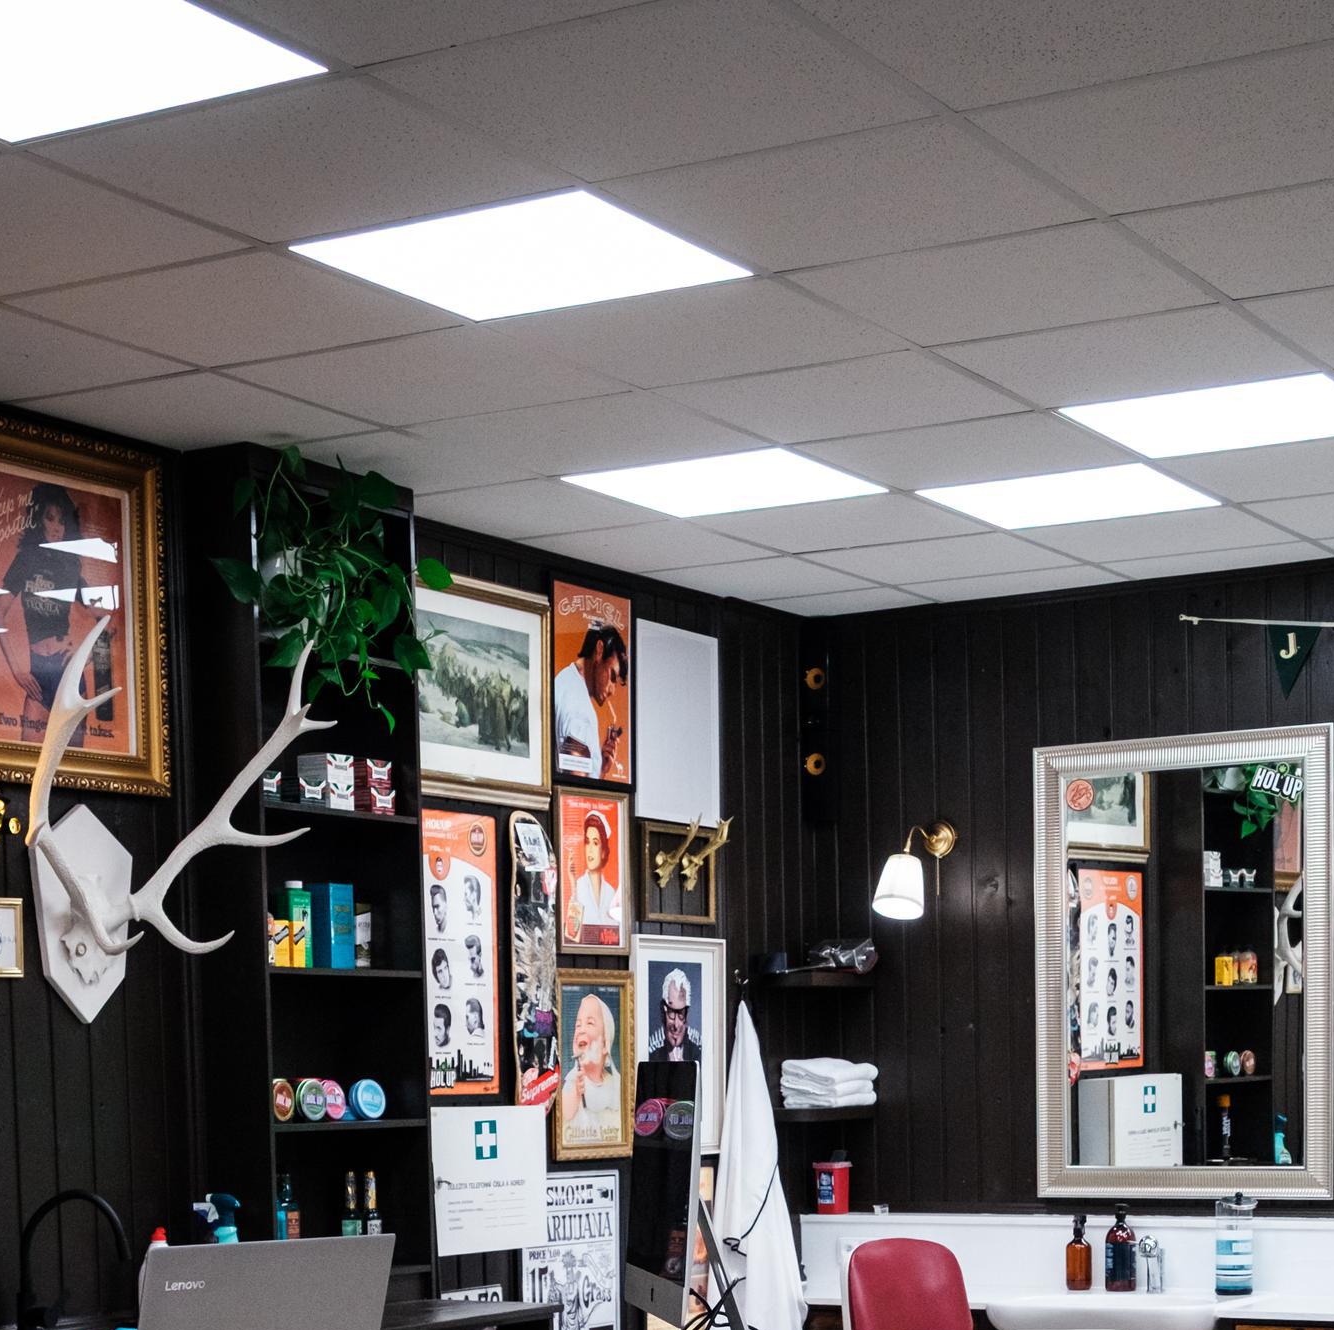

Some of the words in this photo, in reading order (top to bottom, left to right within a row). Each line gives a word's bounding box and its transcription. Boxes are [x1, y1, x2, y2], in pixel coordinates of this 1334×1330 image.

[558, 594, 625, 631] CAMEL
[1279, 632, 1298, 660] J
[521, 1072, 559, 1100] Supreme
[547, 1212, 613, 1243] RIJUANA
[529, 1249, 547, 1260] PRICE
[164, 1277, 206, 1291] Lenovo
[581, 1275, 612, 1308] Grass
